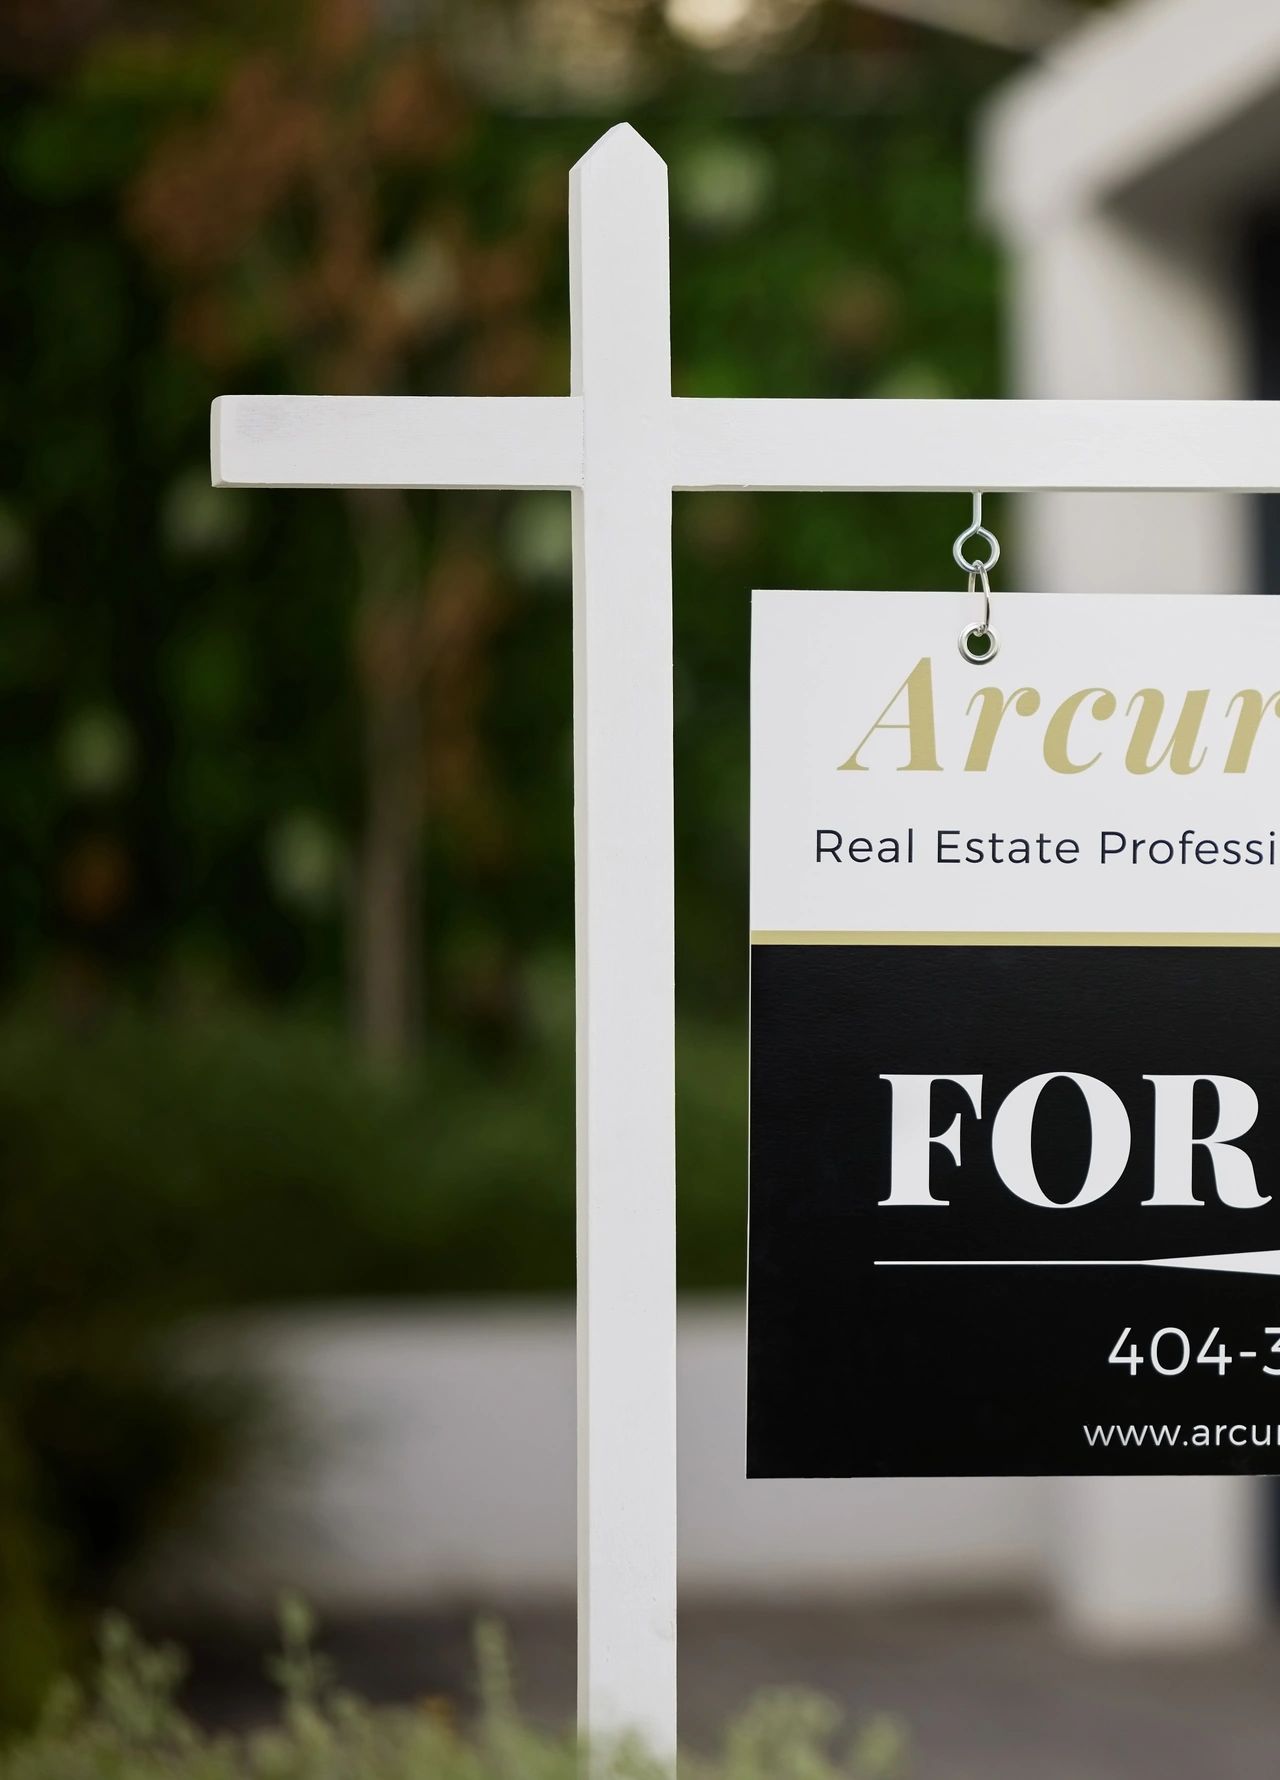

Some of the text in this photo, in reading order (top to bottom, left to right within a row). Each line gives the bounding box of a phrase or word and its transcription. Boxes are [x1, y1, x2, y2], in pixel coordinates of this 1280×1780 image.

[814, 828, 914, 865] Real
[936, 829, 1080, 865] Estate
[876, 1071, 1273, 1210] FOR
